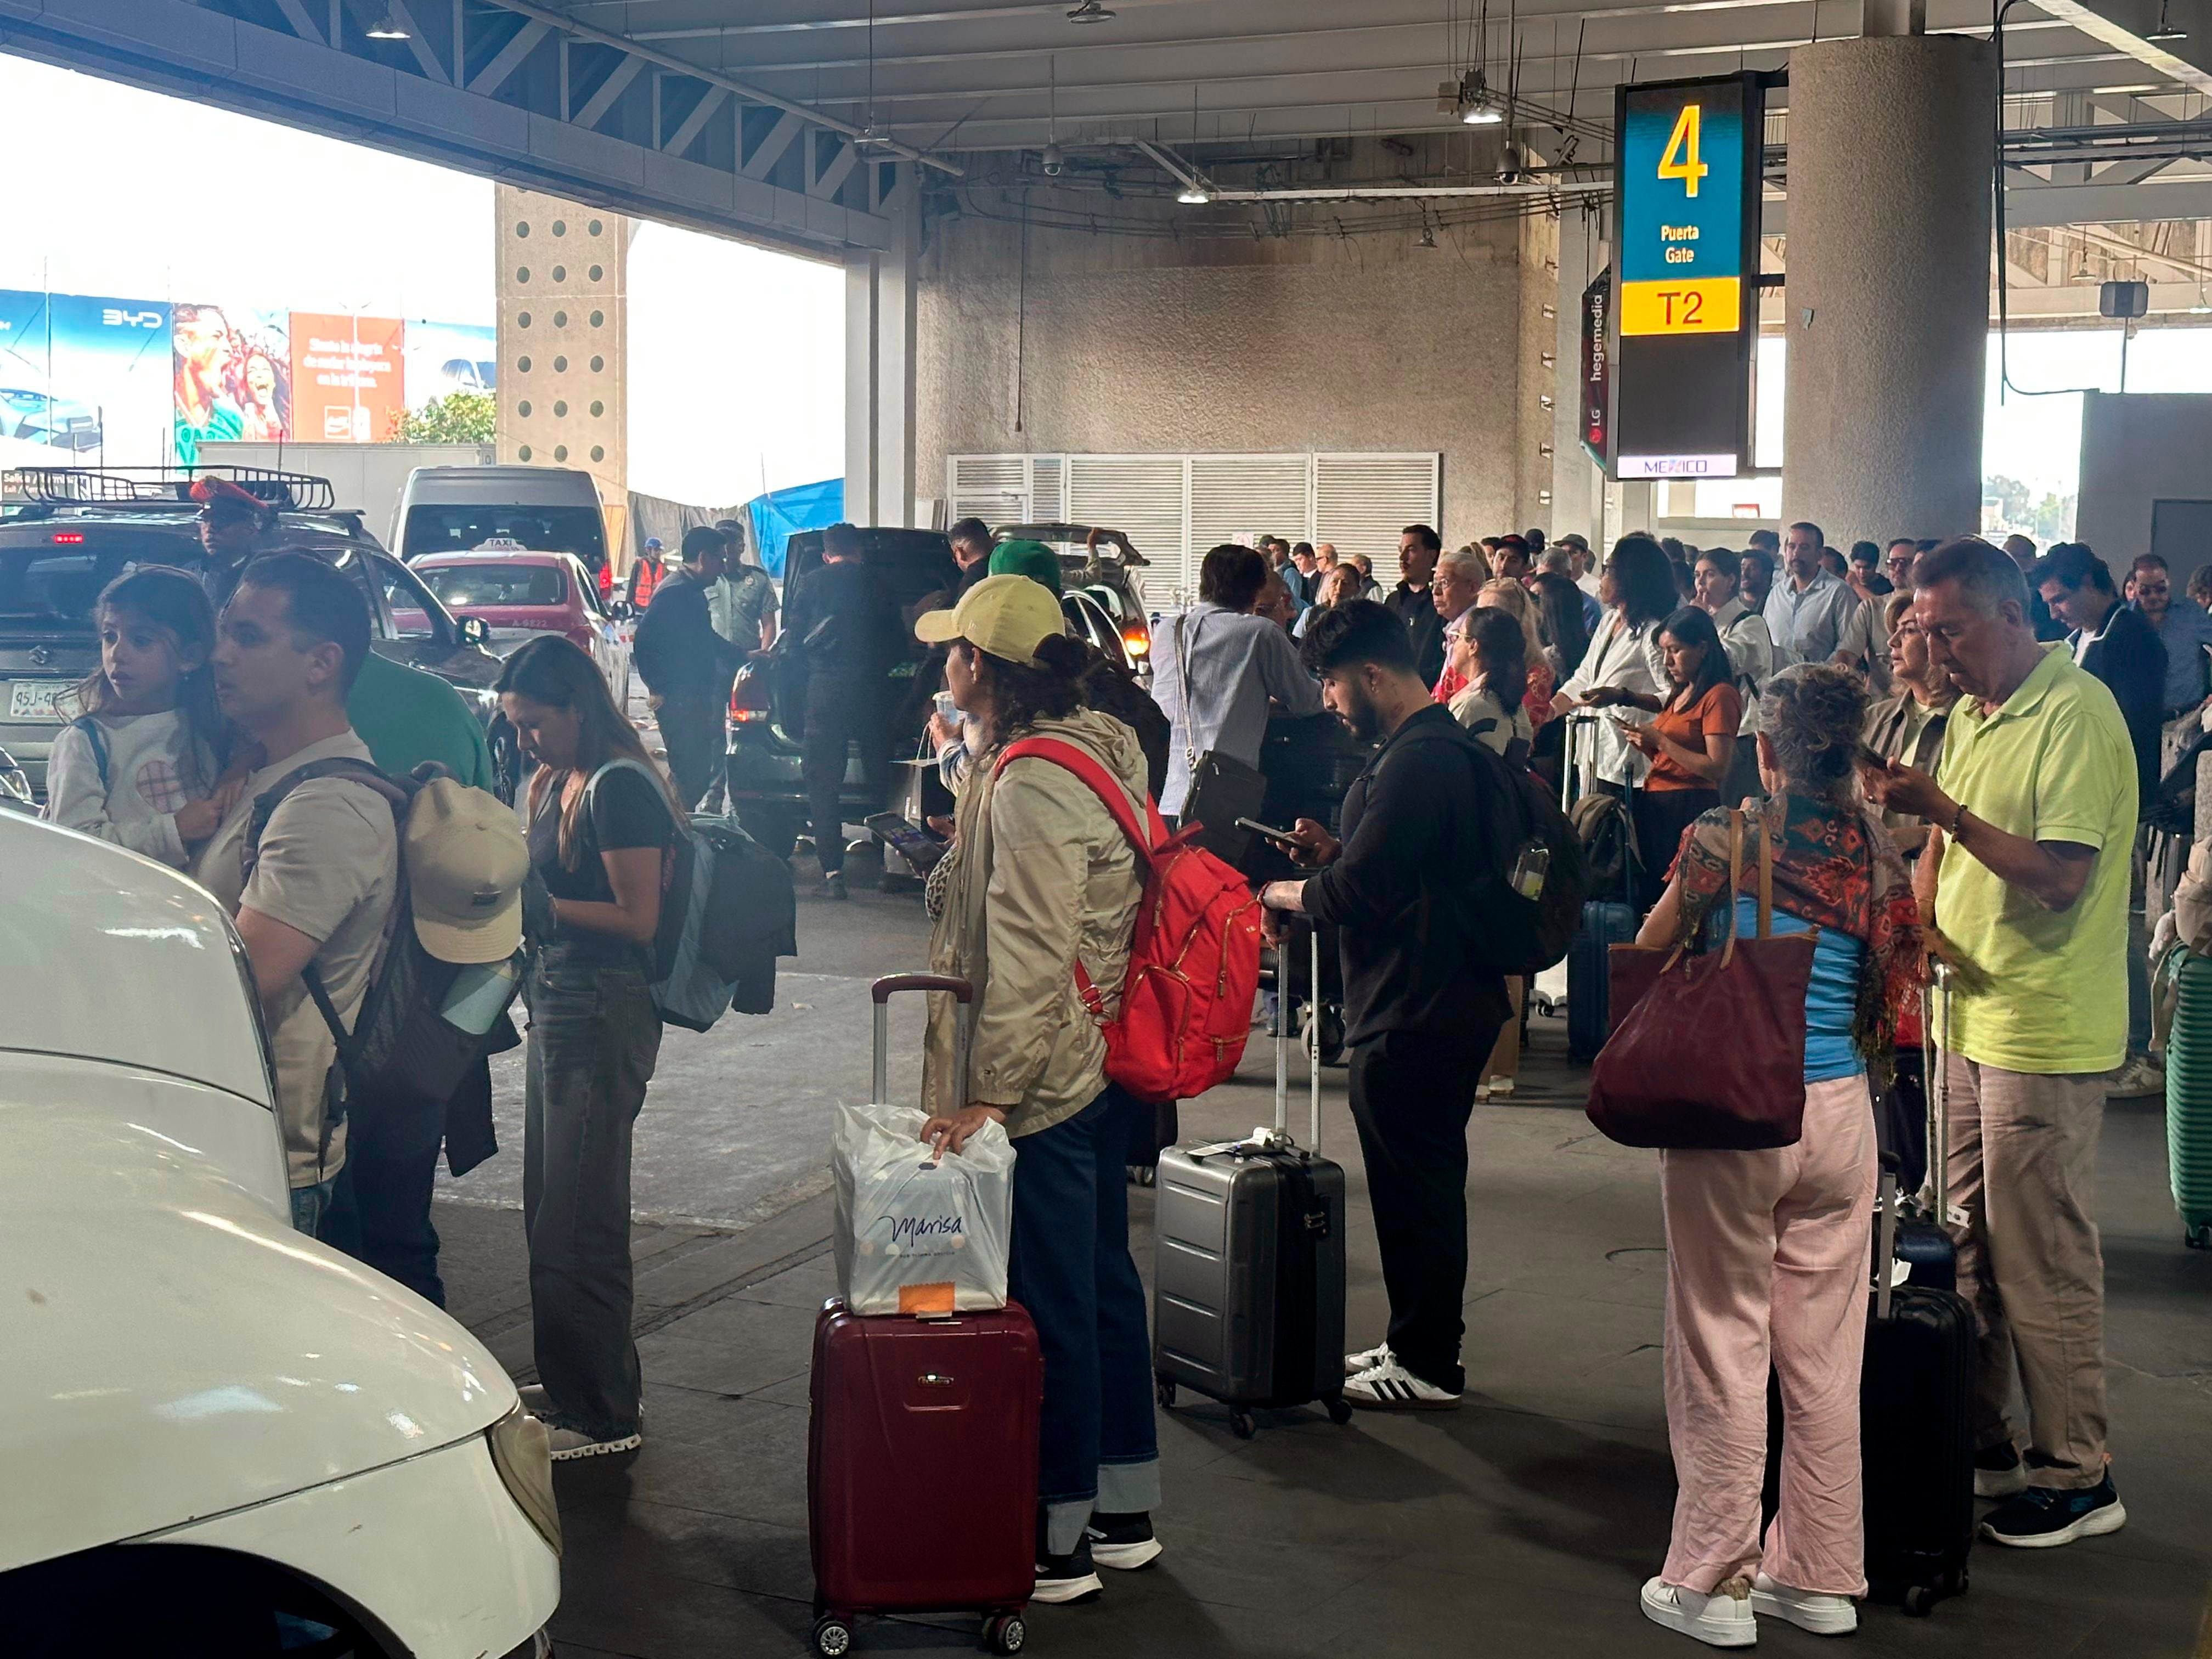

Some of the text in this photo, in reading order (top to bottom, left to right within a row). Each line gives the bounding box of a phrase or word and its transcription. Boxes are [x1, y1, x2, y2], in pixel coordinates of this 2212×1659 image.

[1657, 104, 1708, 198] 4
[1661, 225, 1699, 241] Puerta
[1664, 247, 1695, 263] Gate
[1657, 291, 1703, 325] T2
[103, 309, 163, 329] BYD
[1590, 294, 1605, 382] hegemedia
[1591, 409, 1601, 426] LG
[1644, 460, 1707, 473] MEXICO
[878, 1215, 963, 1247] Marisa
